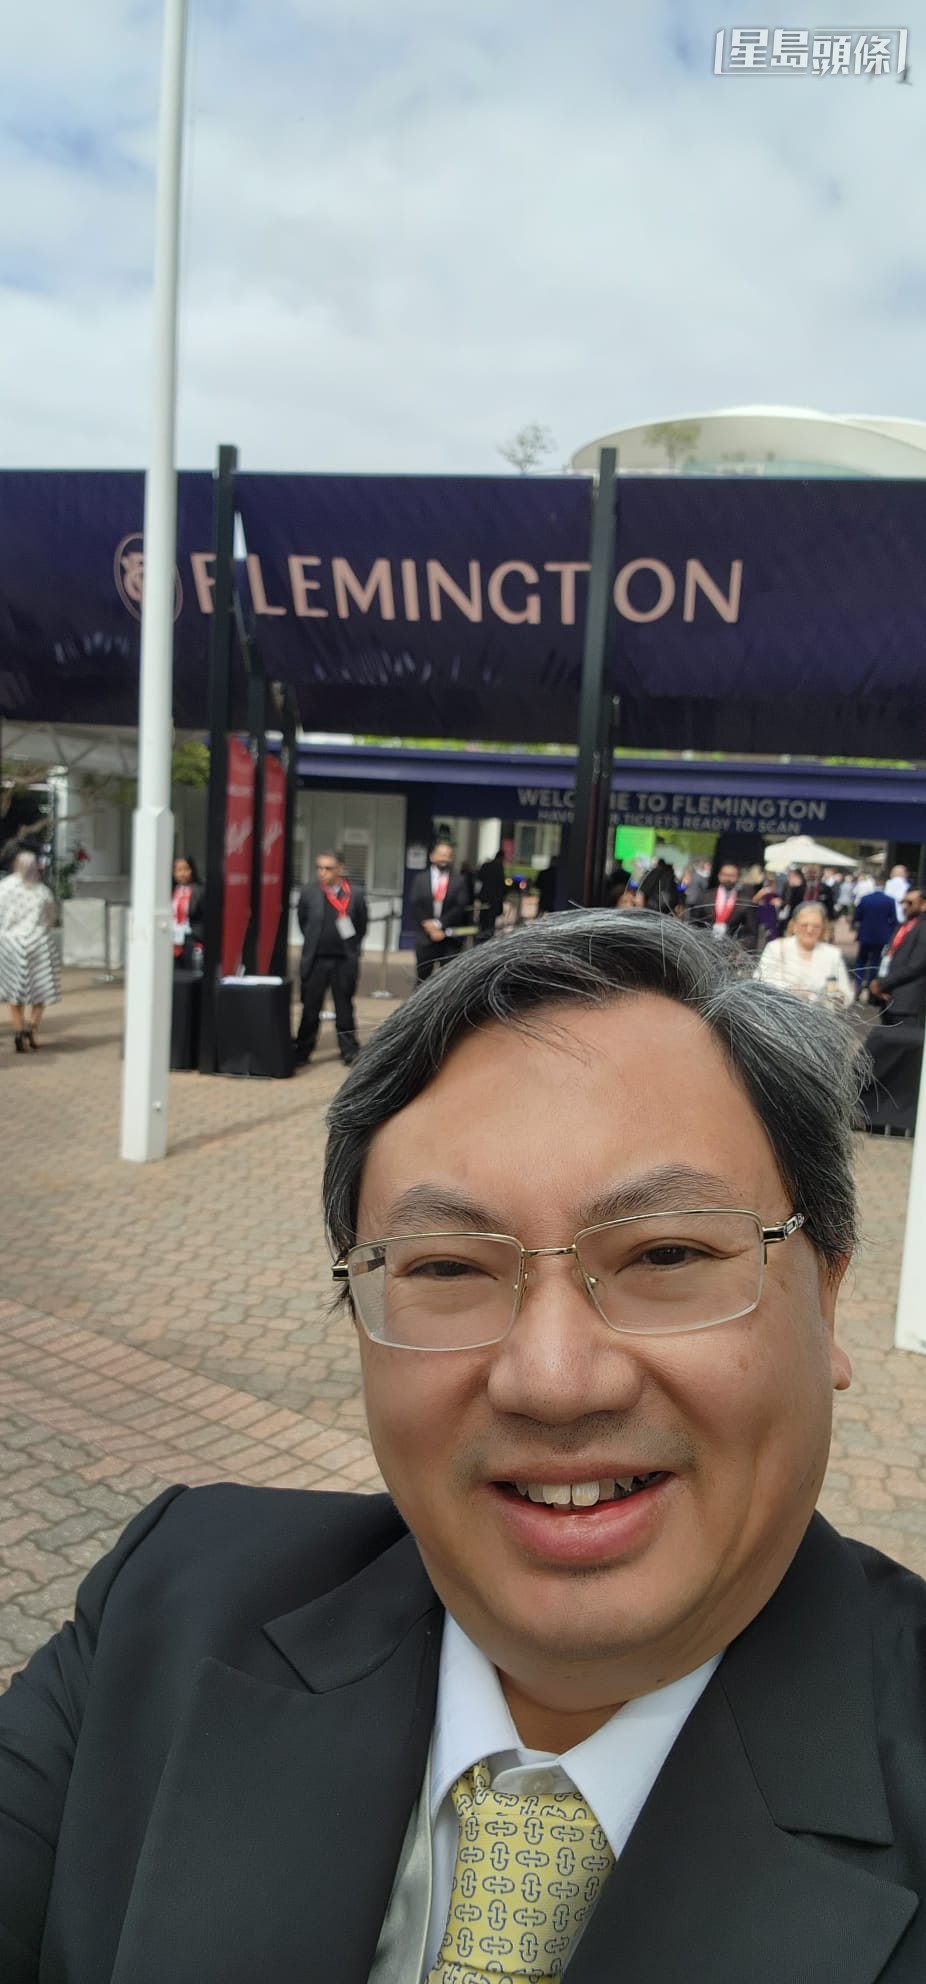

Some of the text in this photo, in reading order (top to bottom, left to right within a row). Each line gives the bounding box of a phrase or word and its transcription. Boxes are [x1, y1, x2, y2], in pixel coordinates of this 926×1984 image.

[190, 551, 744, 626] FLEMINGTON
[517, 788, 826, 821] WELCE TO FLEMINGTON
[624, 813, 680, 829] TICKETS
[683, 815, 730, 831] READY
[736, 817, 754, 833] TO
[758, 818, 801, 835] SCAN
